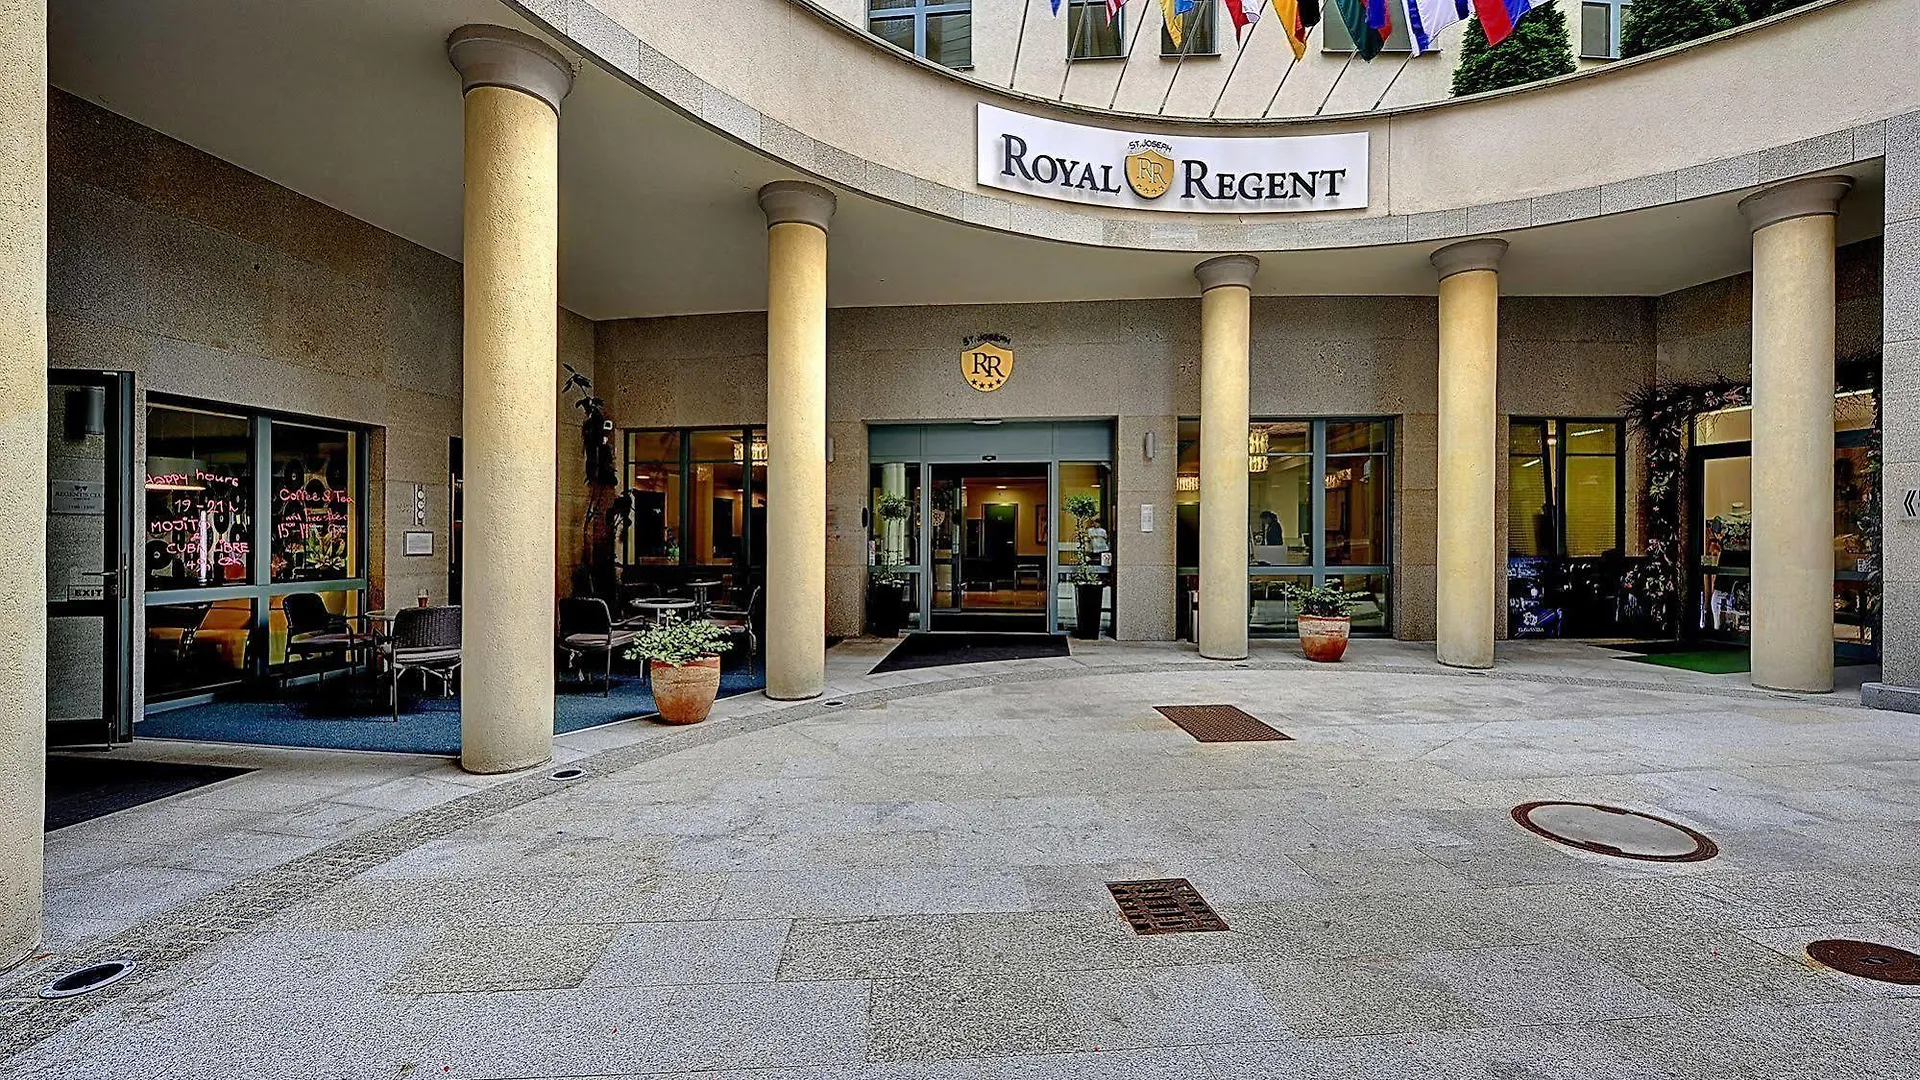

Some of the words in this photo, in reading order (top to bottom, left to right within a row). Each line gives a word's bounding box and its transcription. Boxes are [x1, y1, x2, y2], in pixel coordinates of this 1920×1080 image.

[1001, 134, 1121, 194] ROYAL
[1181, 159, 1346, 200] REGENT
[971, 352, 1005, 378] RR
[195, 469, 239, 487] hours
[279, 488, 321, 501] Coffee
[74, 589, 103, 598] EXIT
